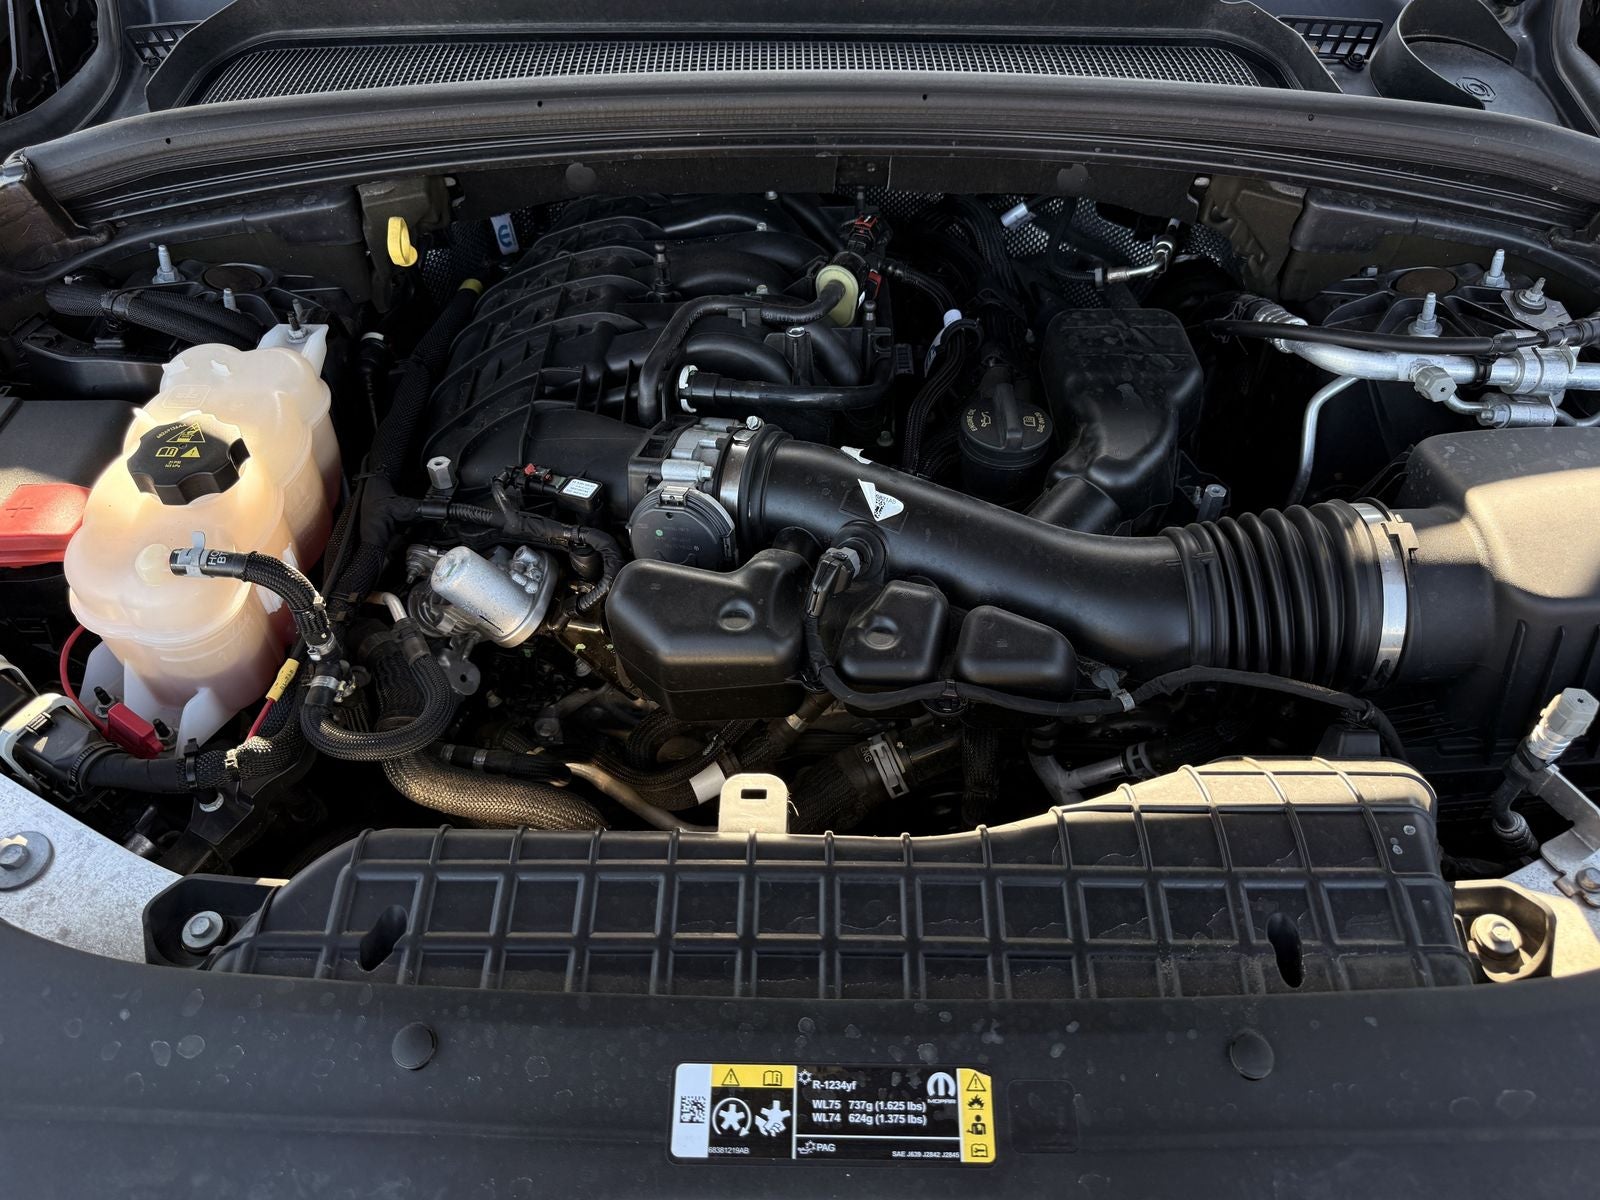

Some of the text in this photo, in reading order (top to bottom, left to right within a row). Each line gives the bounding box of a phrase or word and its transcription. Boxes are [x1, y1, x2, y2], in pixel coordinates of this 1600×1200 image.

[812, 1080, 857, 1092] R-1234yf
[812, 1099, 927, 1113] WL75 737g (1.625 lbs)
[812, 1112, 927, 1126] WL74 624g (1.375 lbs)
[816, 1143, 836, 1152] PAG
[891, 1150, 906, 1158] SAE
